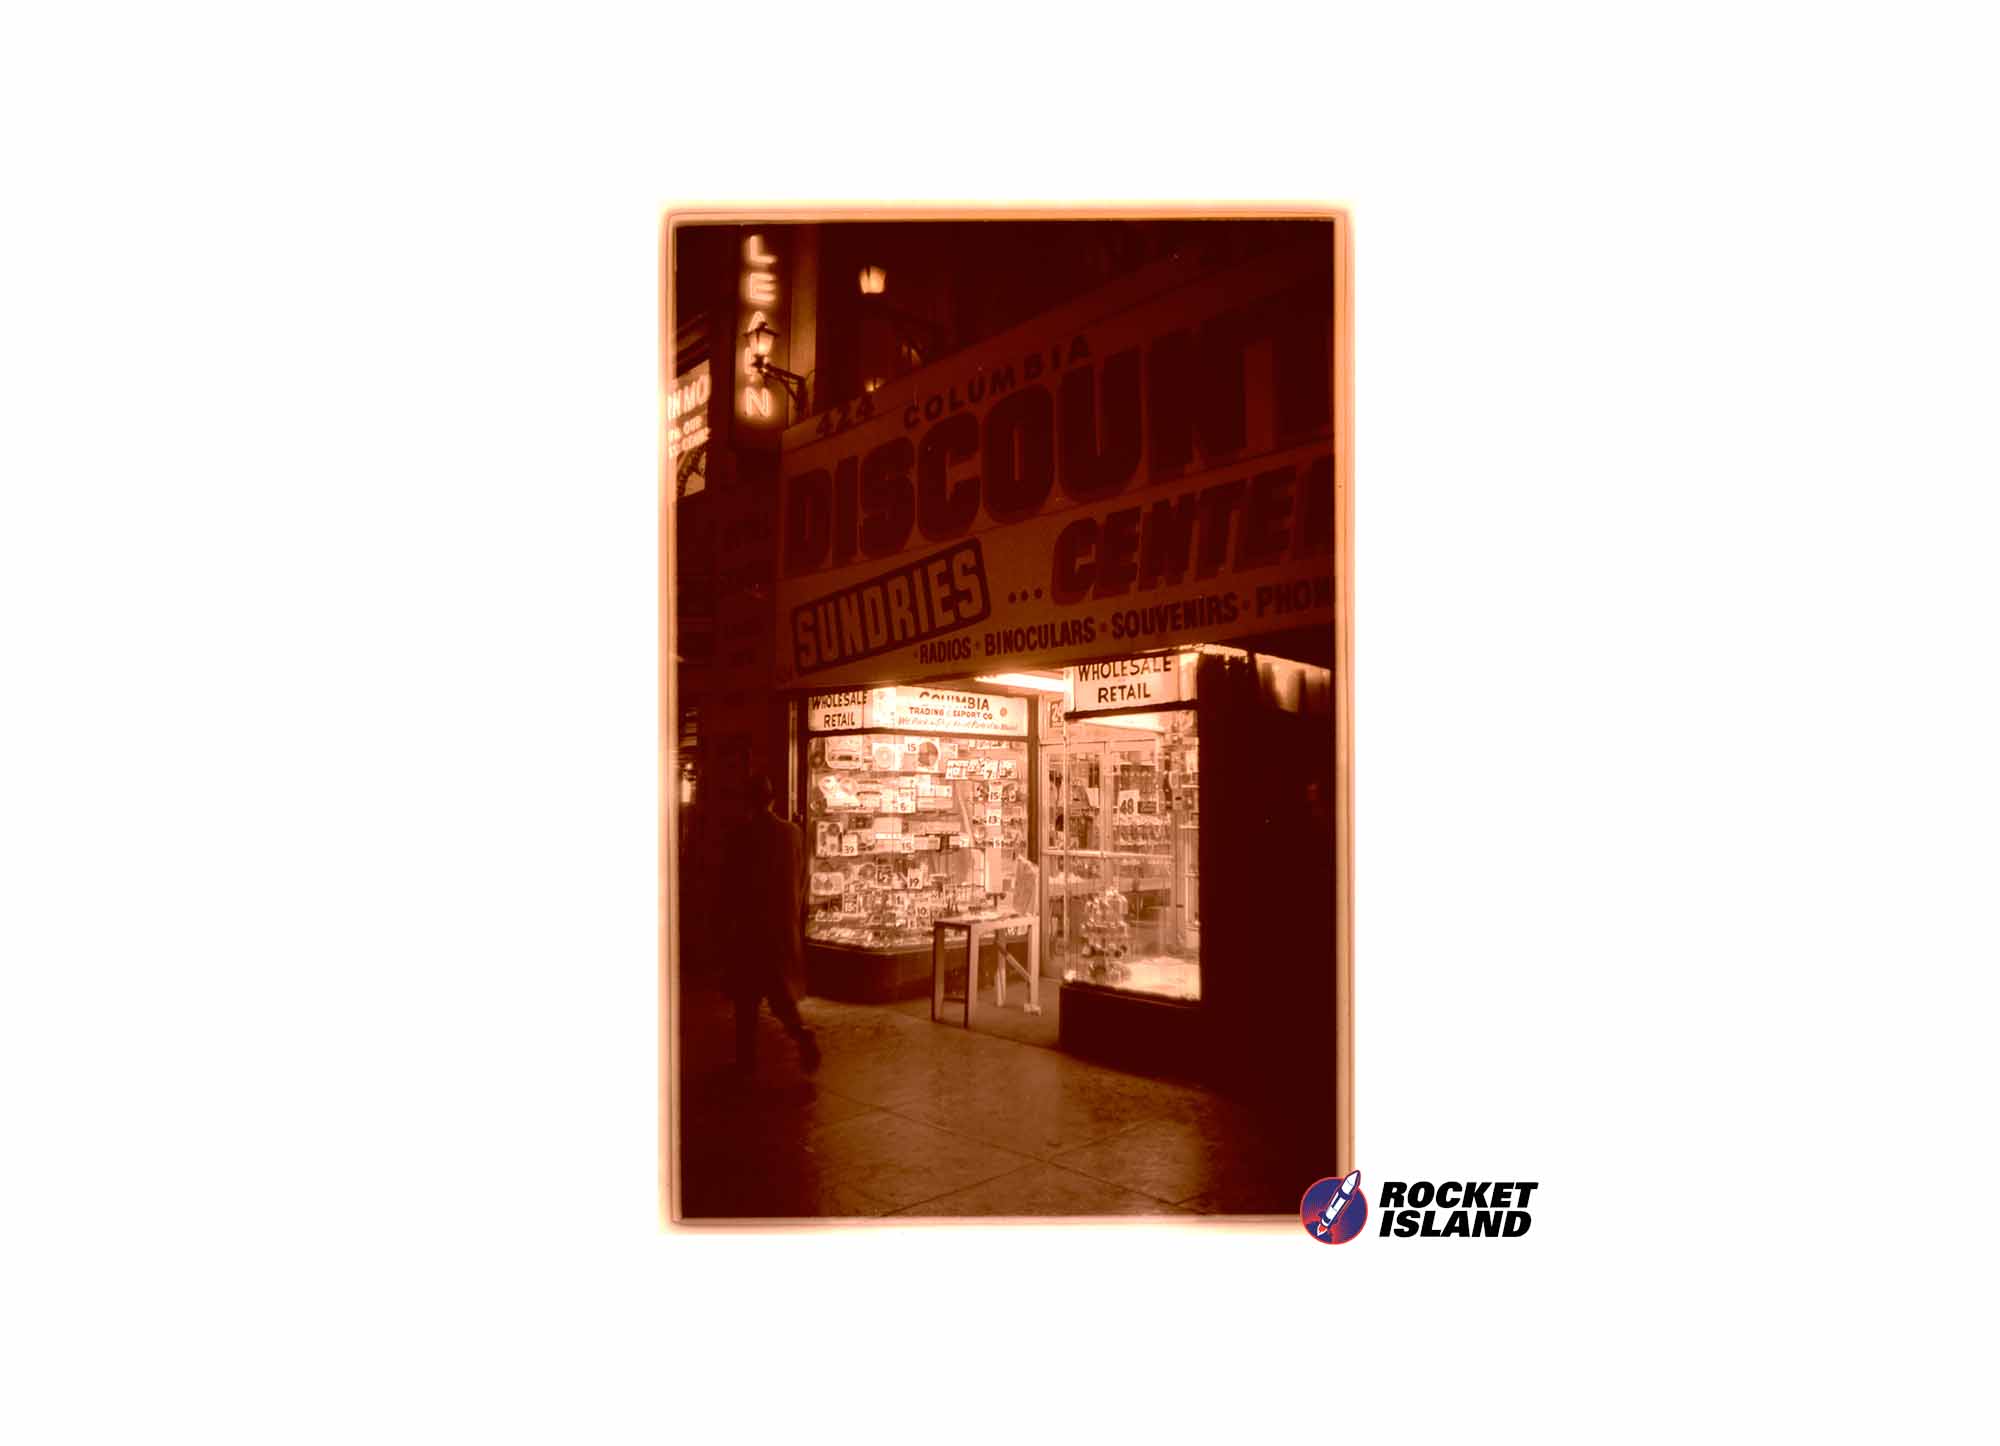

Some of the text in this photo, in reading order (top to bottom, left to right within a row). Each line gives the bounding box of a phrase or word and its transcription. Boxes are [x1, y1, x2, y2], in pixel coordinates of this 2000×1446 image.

[744, 234, 778, 419] LEAN
[903, 334, 1089, 430] COLUMBIA
[798, 549, 984, 669] SUNDRIES
[920, 637, 970, 664] RADIOS
[984, 616, 1096, 656] BINOCULARS
[1111, 592, 1238, 640] SOUVENIRS
[1077, 655, 1172, 683] WHOLESALE
[811, 691, 868, 710] WHOLESALE
[1097, 682, 1152, 704] RETAIL
[823, 711, 856, 728] RETAIL
[909, 706, 945, 716] TRADING
[907, 743, 917, 752] 15
[1119, 798, 1134, 815] 48
